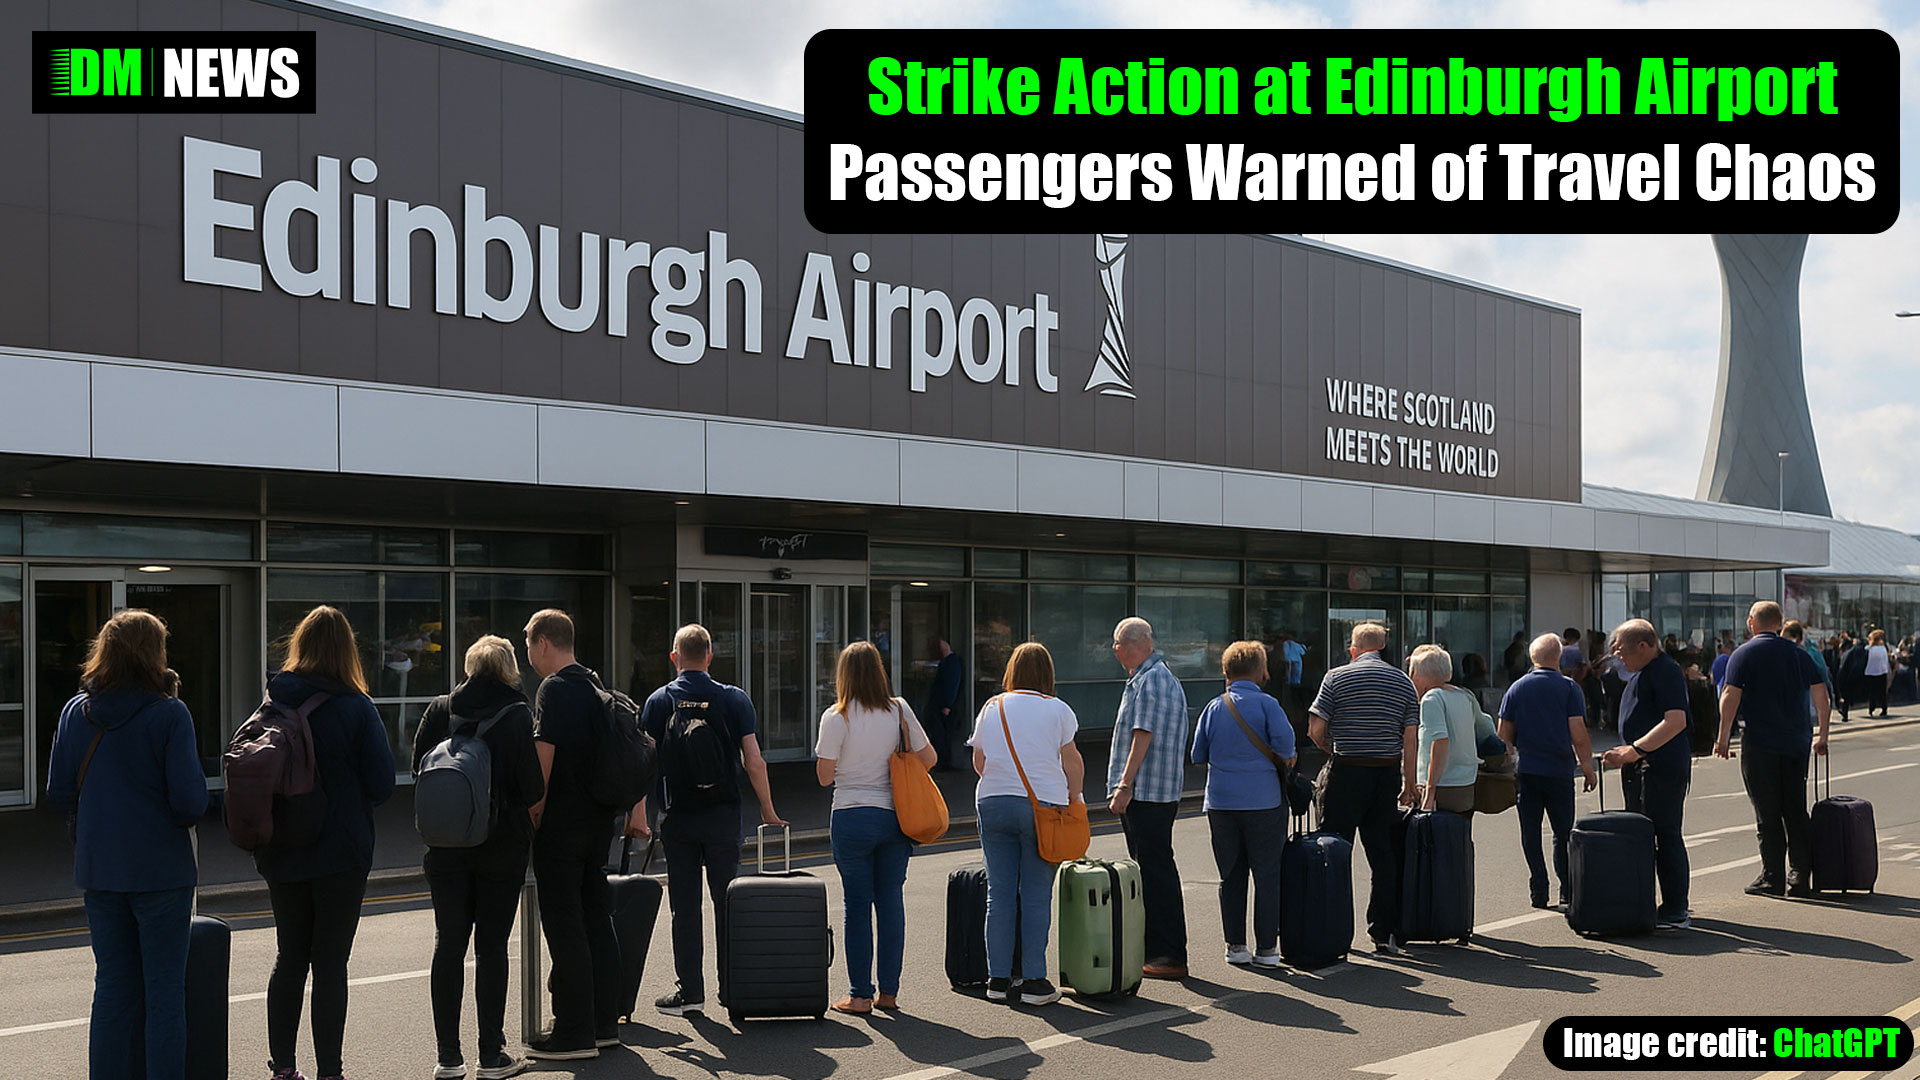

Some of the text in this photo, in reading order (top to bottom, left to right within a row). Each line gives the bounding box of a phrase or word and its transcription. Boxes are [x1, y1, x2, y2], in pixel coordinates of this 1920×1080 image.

[182, 135, 1059, 394] Edinburgh Airport
[1326, 376, 1496, 435] WHERE SCOTLAND
[1326, 426, 1499, 478] MEETS THE WORLD
